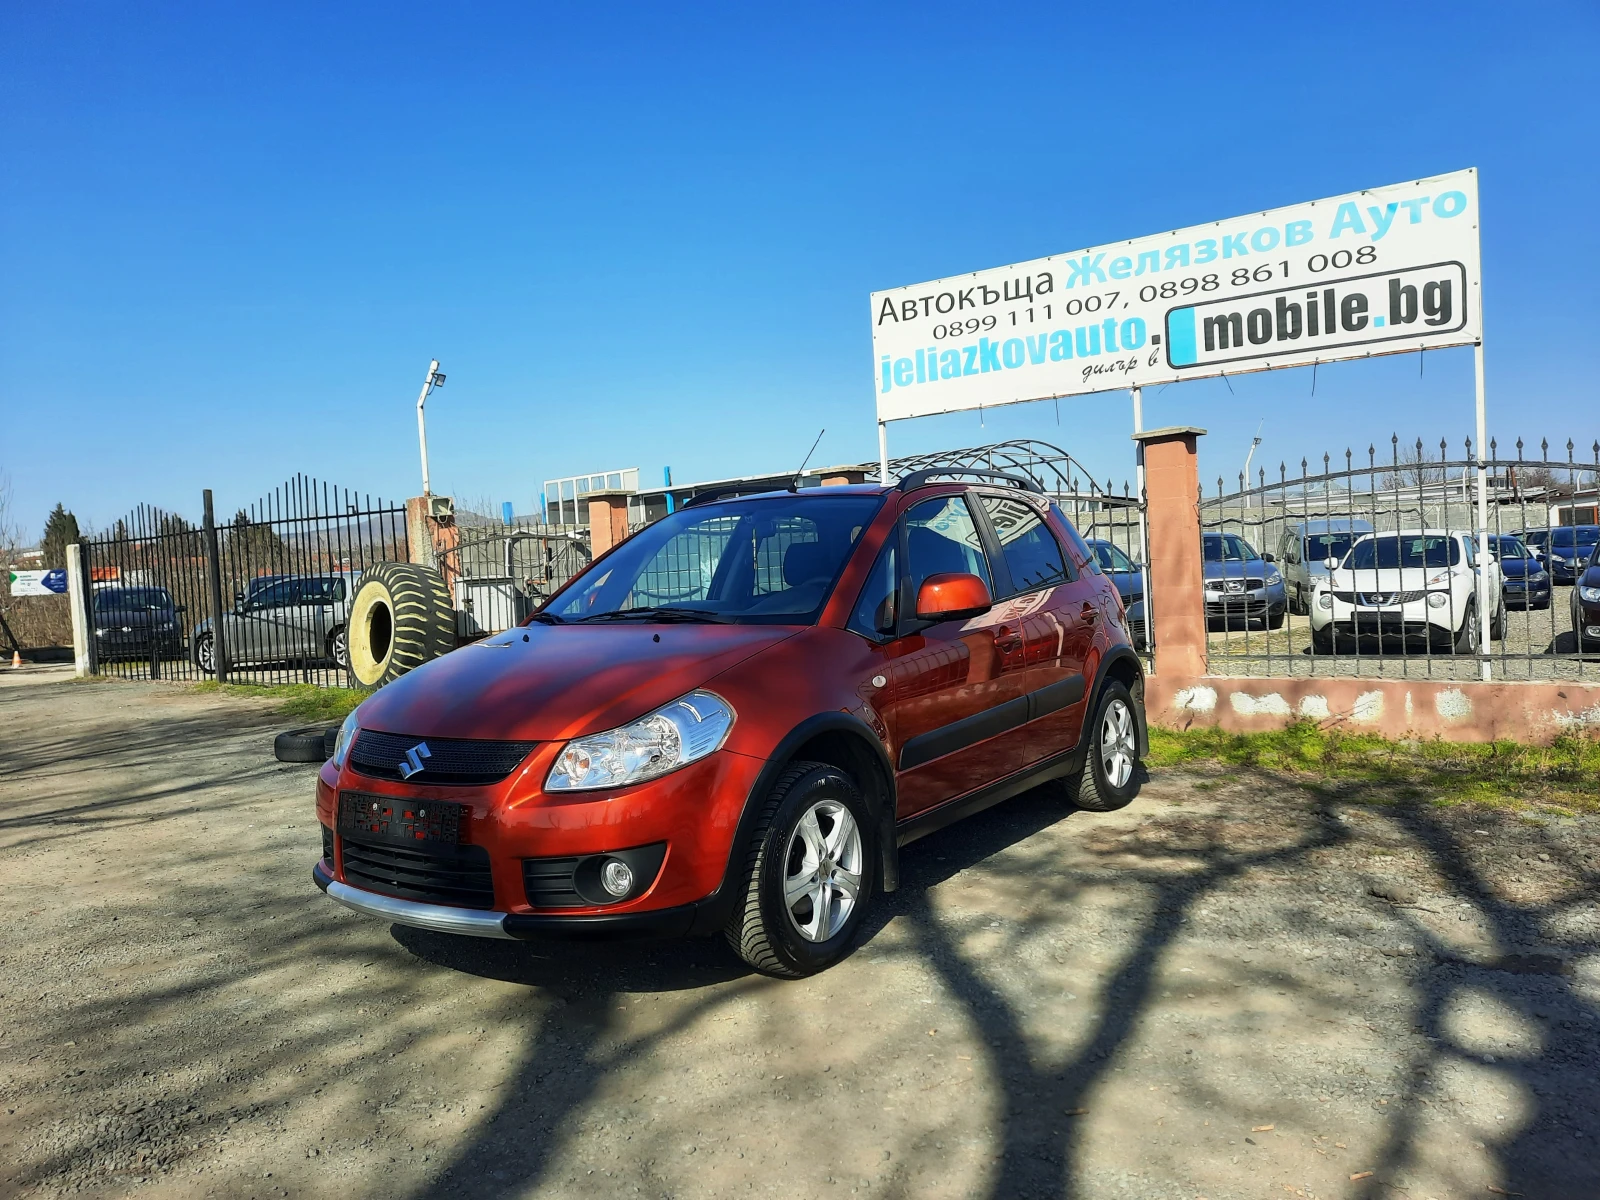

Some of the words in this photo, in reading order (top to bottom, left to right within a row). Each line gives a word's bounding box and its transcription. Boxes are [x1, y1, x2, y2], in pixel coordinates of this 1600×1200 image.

[878, 272, 1054, 326] Автокъща
[1065, 219, 1314, 289] Желязков
[1329, 190, 1467, 242] Ауто
[933, 315, 997, 340] 0899
[1008, 304, 1052, 326] 111
[1066, 291, 1129, 315] 007,
[1139, 273, 1220, 302] 0898
[1231, 260, 1289, 286] 861
[1307, 245, 1377, 273] 008
[1203, 278, 1453, 352] mobile.bg
[1082, 355, 1138, 383] дилър
